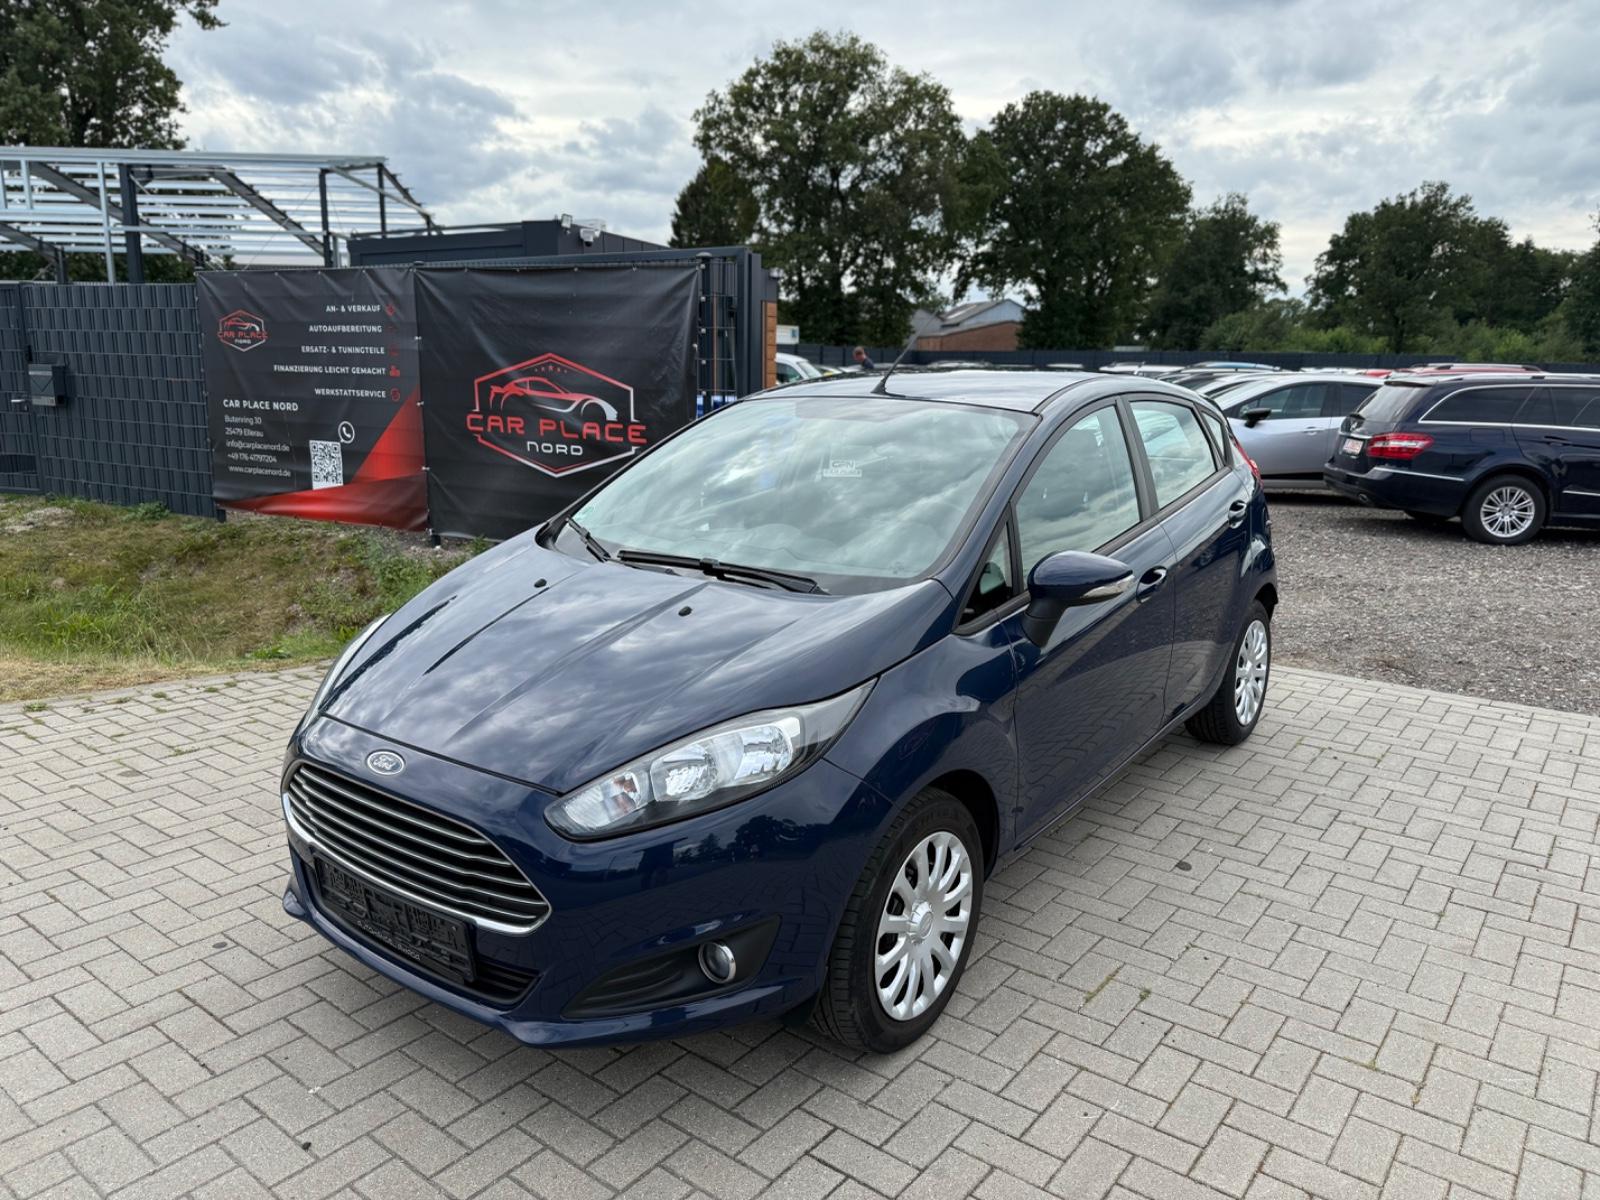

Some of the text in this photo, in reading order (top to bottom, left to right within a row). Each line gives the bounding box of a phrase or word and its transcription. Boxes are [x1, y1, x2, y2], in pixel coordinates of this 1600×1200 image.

[340, 305, 346, 313] &
[347, 304, 381, 313] VERKAUF
[309, 325, 382, 333] AUTOAUFBEREITUNG
[301, 346, 385, 355] ERSATZ- & TUNINGTEILE
[273, 364, 386, 375] FINANZIERUNG LEICHT GEMACHT
[314, 388, 386, 398] WERKSTATTSERVICE
[223, 399, 299, 411] CAR PLACE NORD
[466, 414, 648, 444] CAR PLACE
